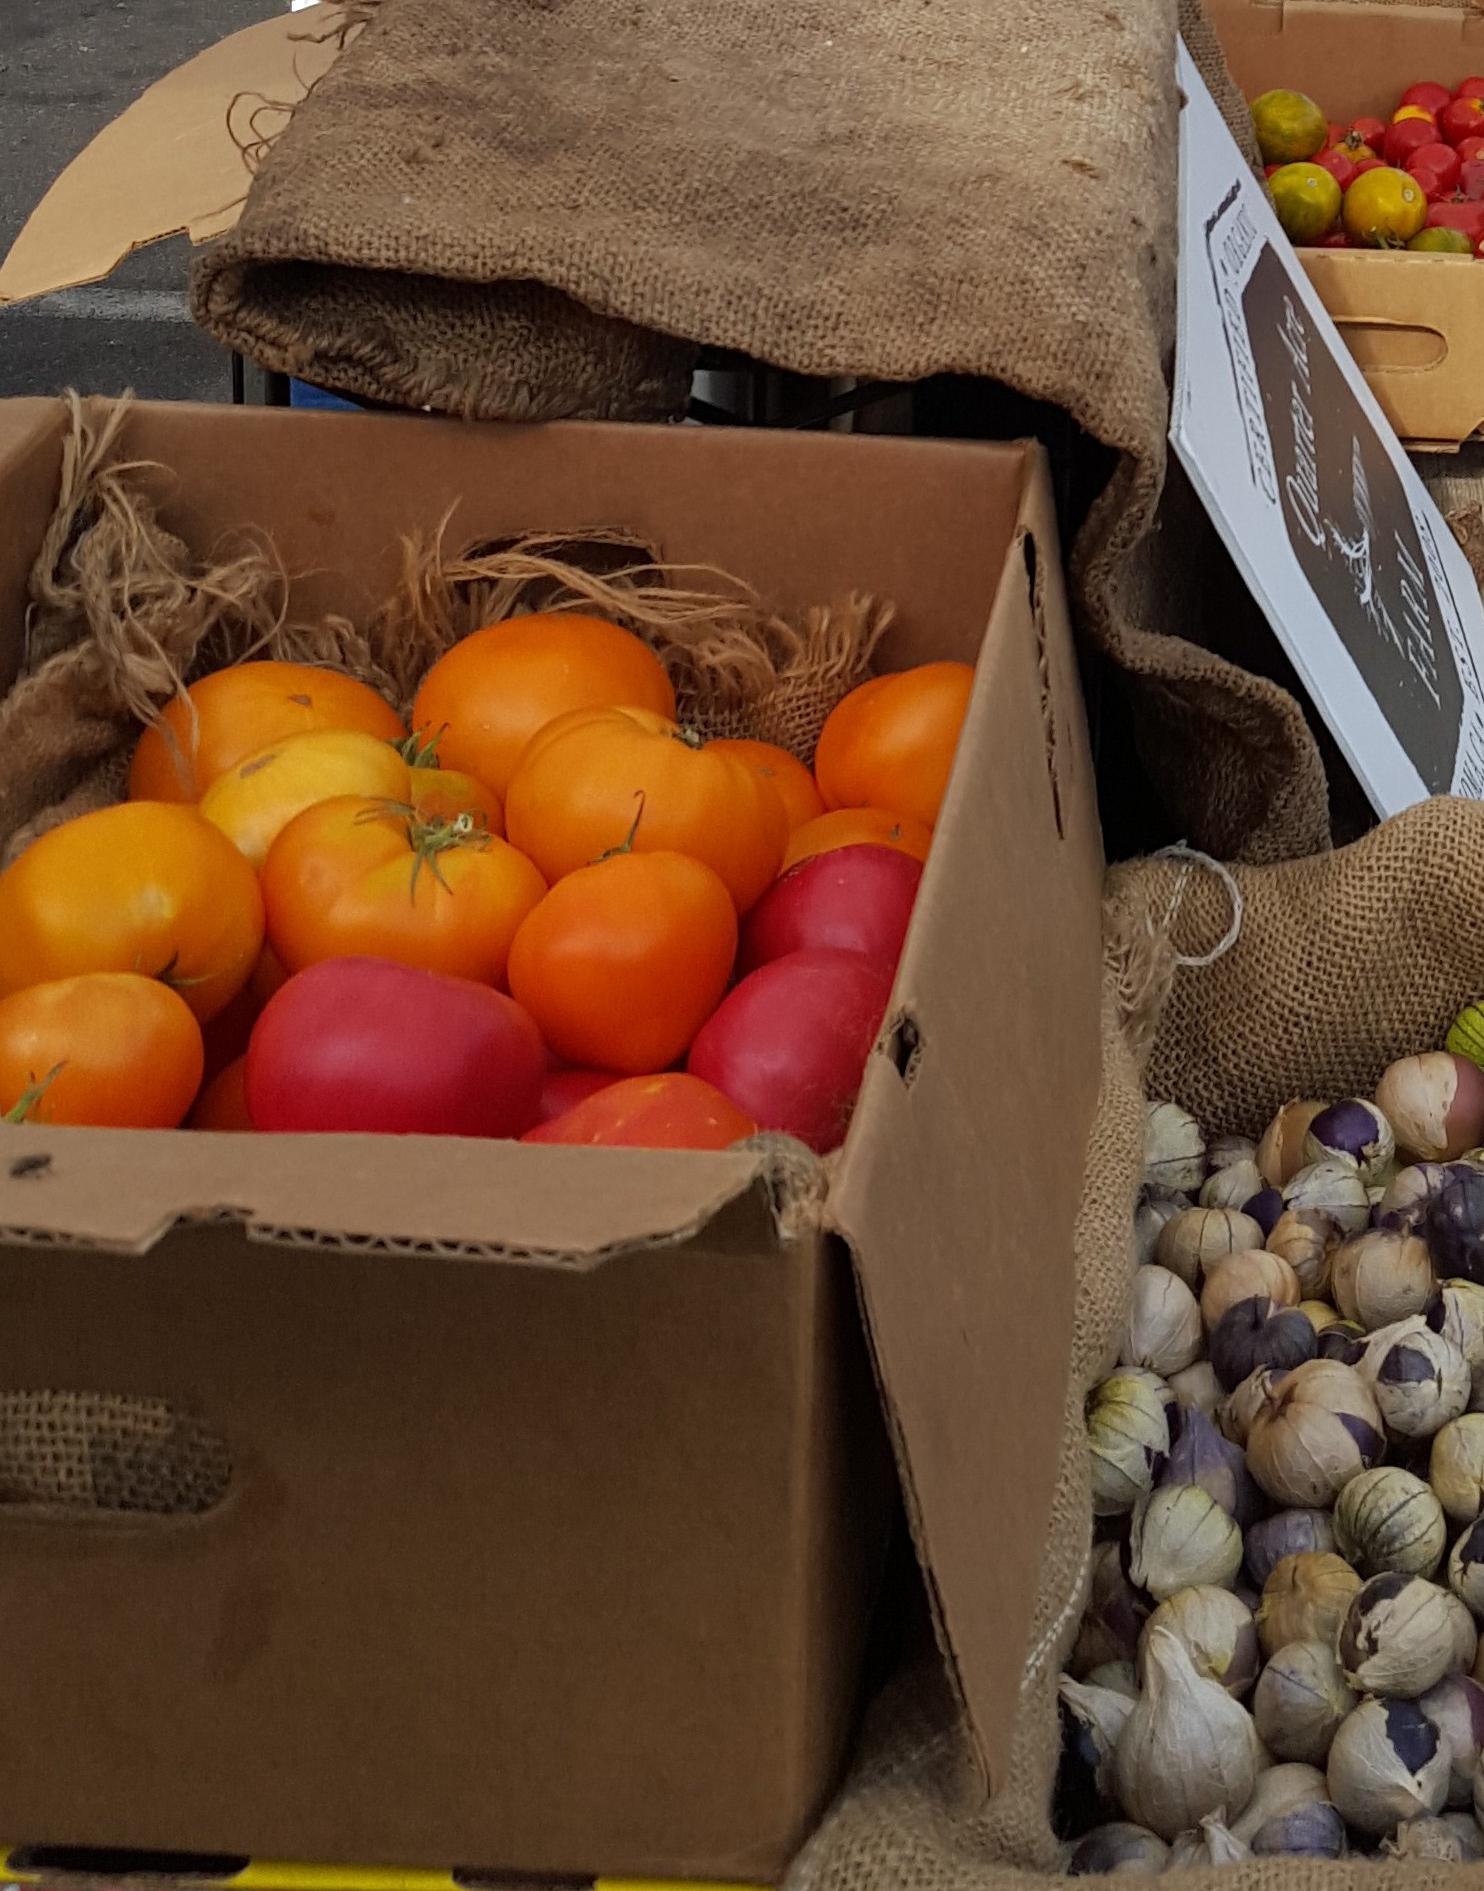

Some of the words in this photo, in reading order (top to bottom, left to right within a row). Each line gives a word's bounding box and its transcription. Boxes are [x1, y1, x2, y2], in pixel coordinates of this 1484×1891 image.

[1222, 287, 1276, 504] CERTIFIED
[1277, 295, 1311, 394] Acre
[1286, 379, 1326, 550] Quarter
[1393, 528, 1441, 710] FARM
